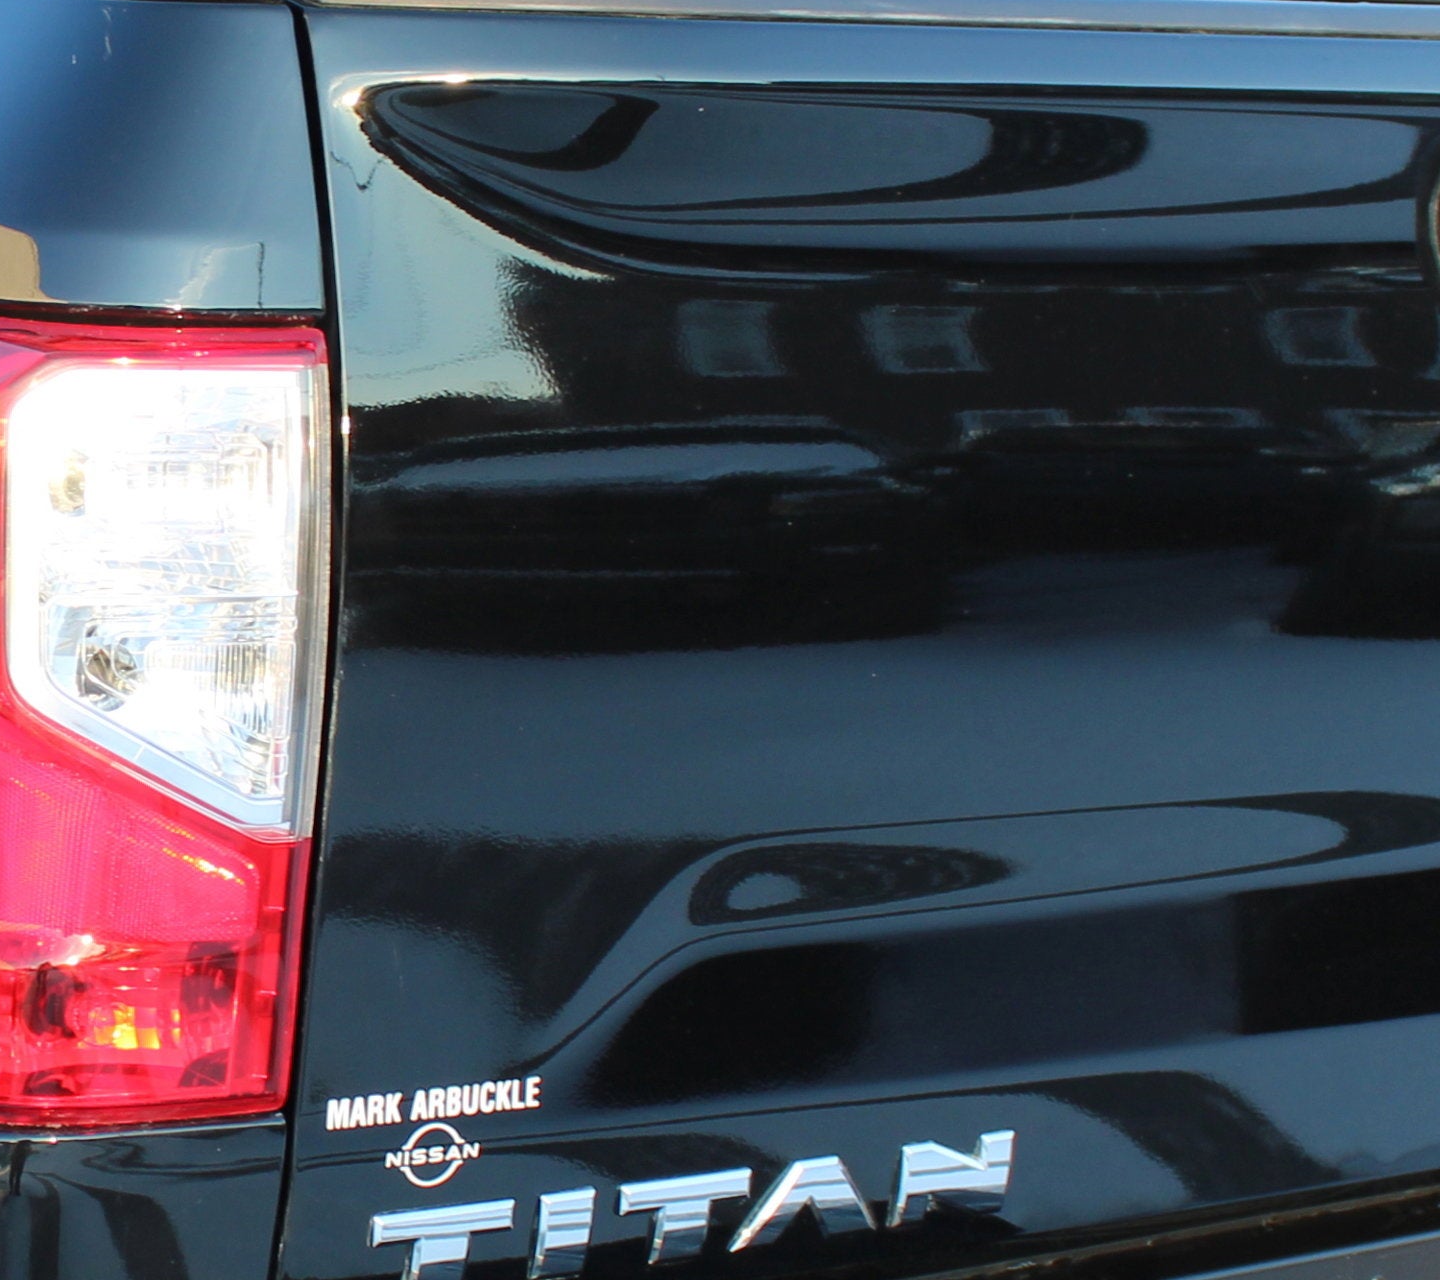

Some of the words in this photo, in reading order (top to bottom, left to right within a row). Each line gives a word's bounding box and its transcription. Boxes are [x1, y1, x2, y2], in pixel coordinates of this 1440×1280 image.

[325, 1086, 404, 1131] MARK
[409, 1075, 543, 1122] ARBUCKLE
[384, 1141, 481, 1169] NISSAN
